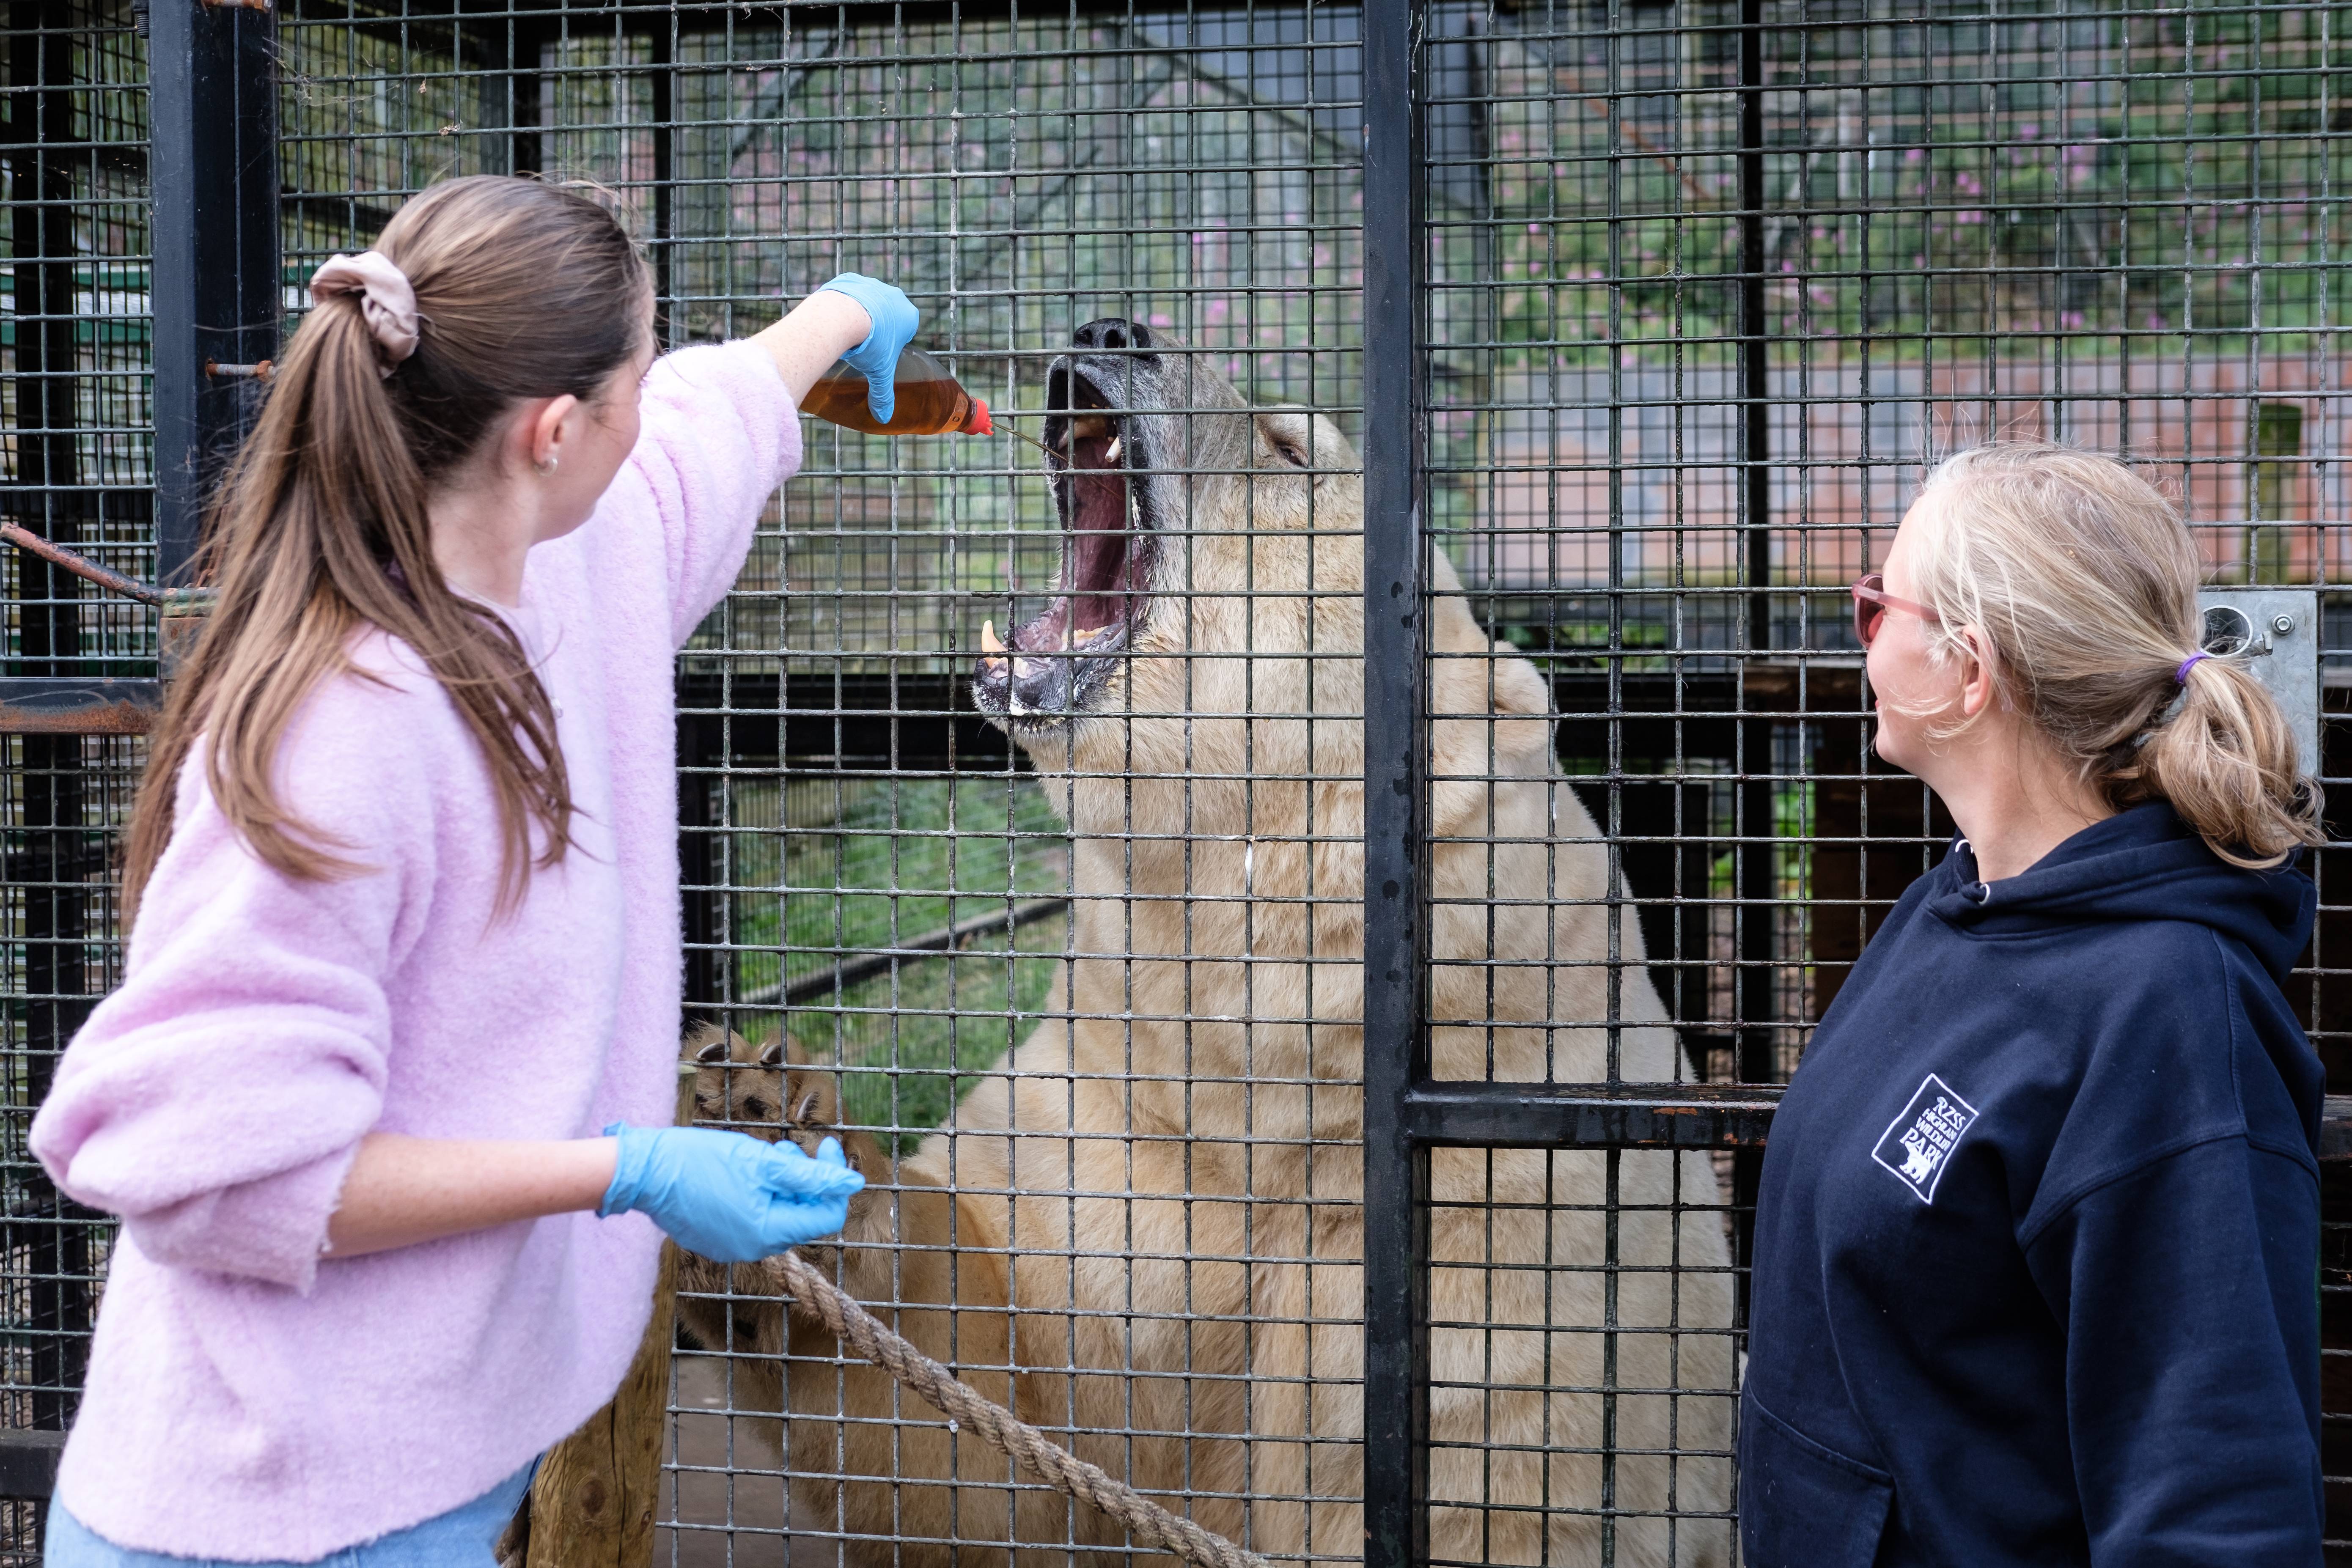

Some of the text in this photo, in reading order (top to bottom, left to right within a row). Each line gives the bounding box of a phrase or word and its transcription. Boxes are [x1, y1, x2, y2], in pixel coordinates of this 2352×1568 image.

[1922, 1108, 1957, 1141] HIGHLAN
[1932, 1096, 1966, 1131] RZSS
[1899, 1127, 1943, 1170] PARK
